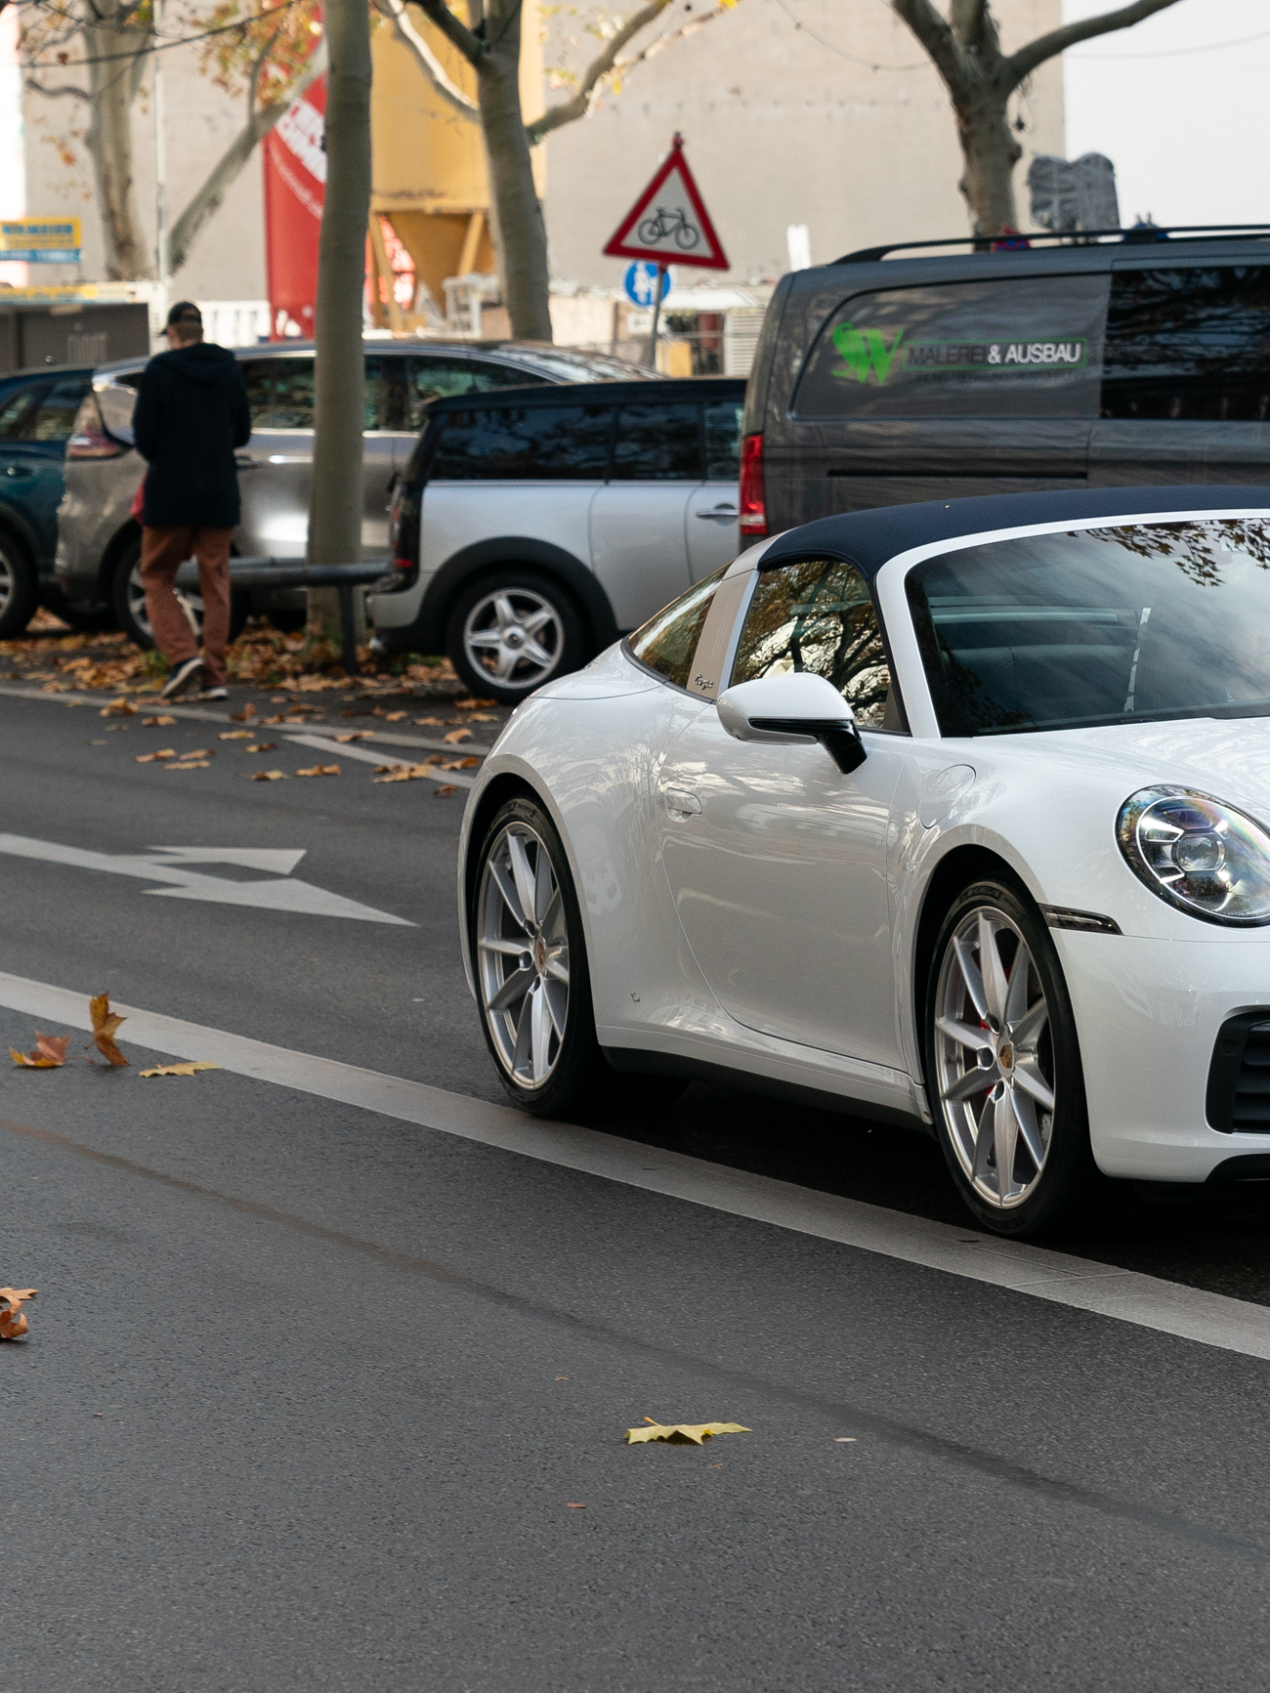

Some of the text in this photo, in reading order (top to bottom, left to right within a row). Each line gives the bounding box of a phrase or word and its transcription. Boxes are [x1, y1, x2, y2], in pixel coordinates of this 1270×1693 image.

[909, 343, 1081, 365] MALEREI & AUSBAU
